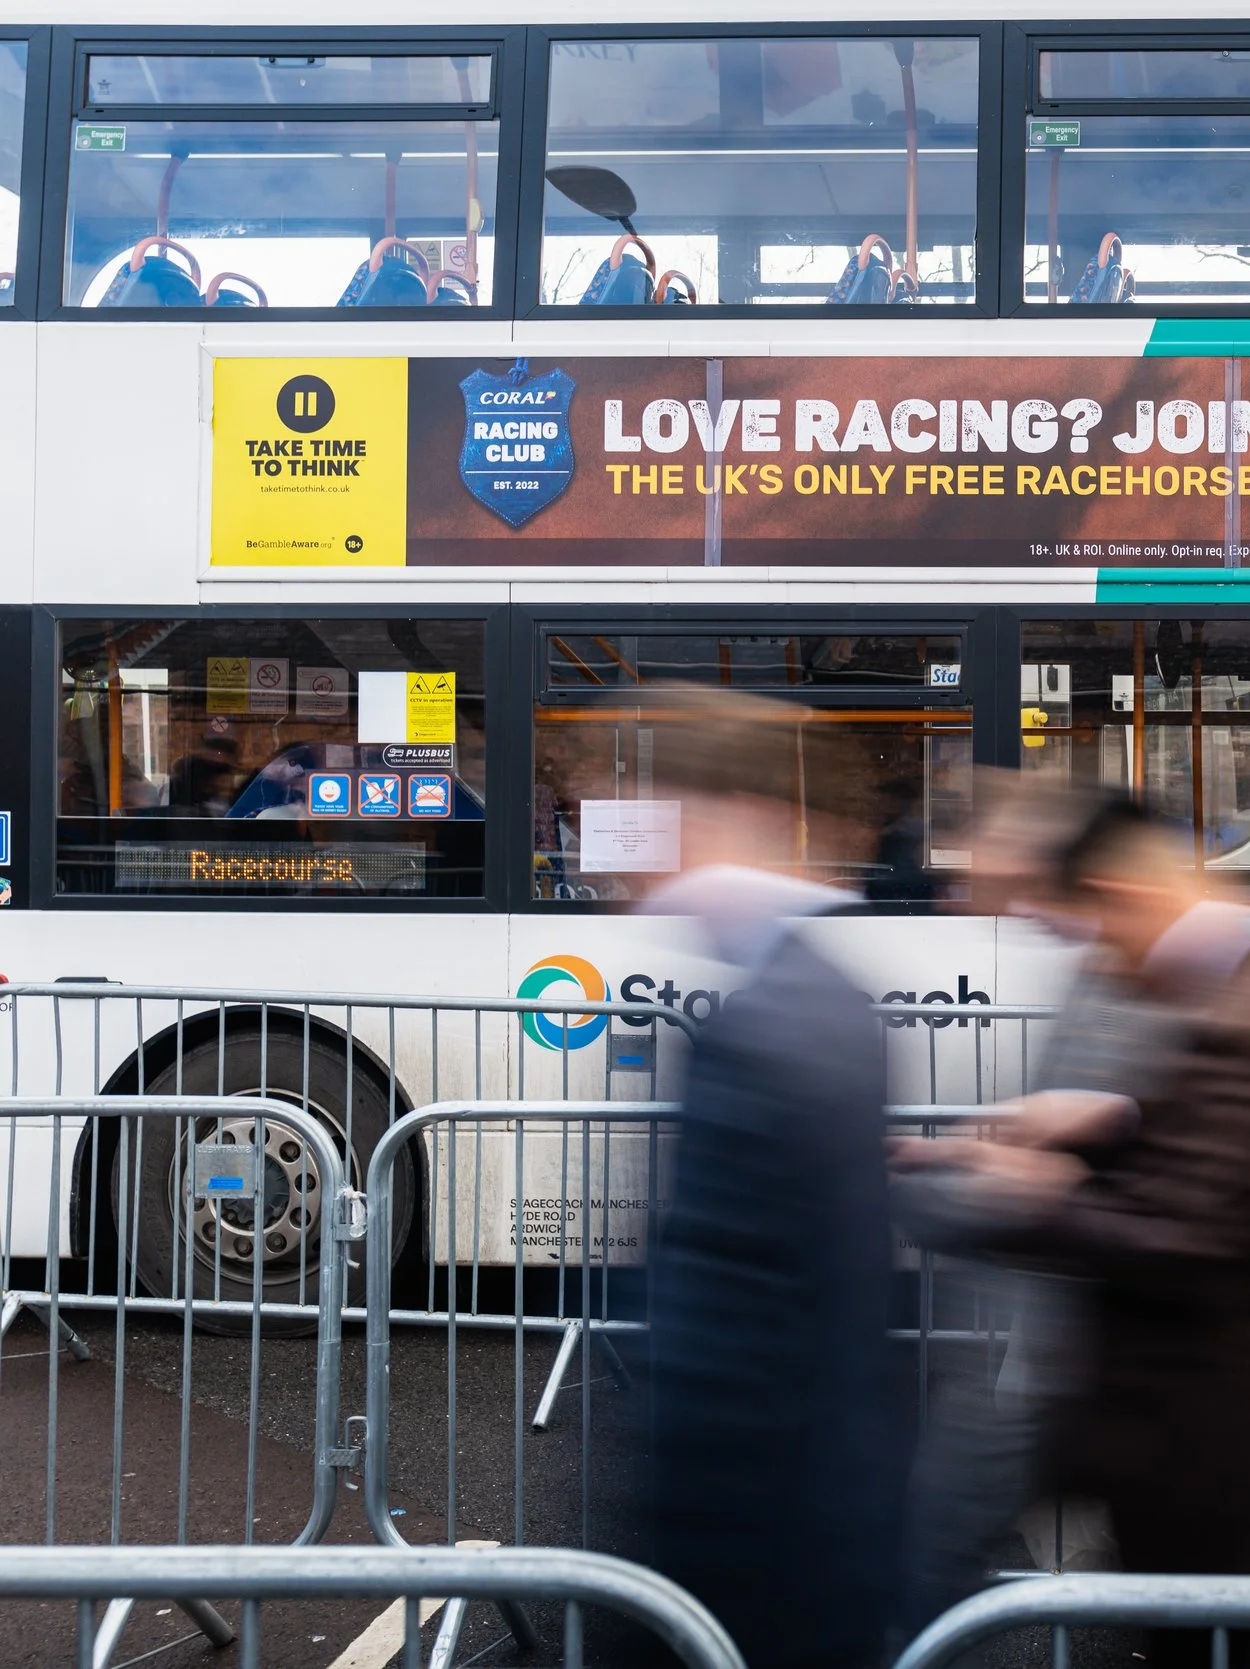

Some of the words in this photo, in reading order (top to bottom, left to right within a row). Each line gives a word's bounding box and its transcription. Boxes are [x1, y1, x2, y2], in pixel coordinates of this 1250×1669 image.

[91, 130, 124, 140] Emergency
[1045, 126, 1079, 135] Emergency
[479, 391, 545, 405] CORAL
[473, 421, 558, 440] RACING
[603, 399, 781, 453] LOVE
[795, 398, 1103, 454] RACING?
[245, 440, 302, 457] TAKE
[310, 440, 366, 457] TIME
[485, 444, 546, 463] CLUB
[252, 460, 287, 477] TO
[290, 460, 360, 477] THINK
[493, 480, 512, 490] EST.
[514, 480, 539, 490] 2022
[605, 464, 684, 495] THE
[695, 464, 784, 496] UK'S
[794, 464, 895, 496] ONLY
[905, 464, 1005, 496] FREE
[260, 484, 350, 494] taketimetothink.co.uk
[347, 540, 361, 549] 18+
[1029, 544, 1053, 555] 18+.
[1055, 544, 1071, 555] UK
[1073, 544, 1081, 555] &
[1083, 544, 1105, 556] ROI.
[1108, 544, 1141, 556] Online
[1144, 544, 1168, 558] only.
[1171, 545, 1203, 559] Opt-in
[1205, 547, 1225, 559] req.
[932, 668, 960, 683] Sta
[406, 749, 450, 757] PLUSBUS
[191, 851, 352, 880] Racecourse
[620, 974, 991, 1029] Staach
[510, 1212, 541, 1221] HDE
[543, 1212, 575, 1221] ROD
[594, 1237, 615, 1247] M2
[617, 1237, 638, 1247] 6JS
